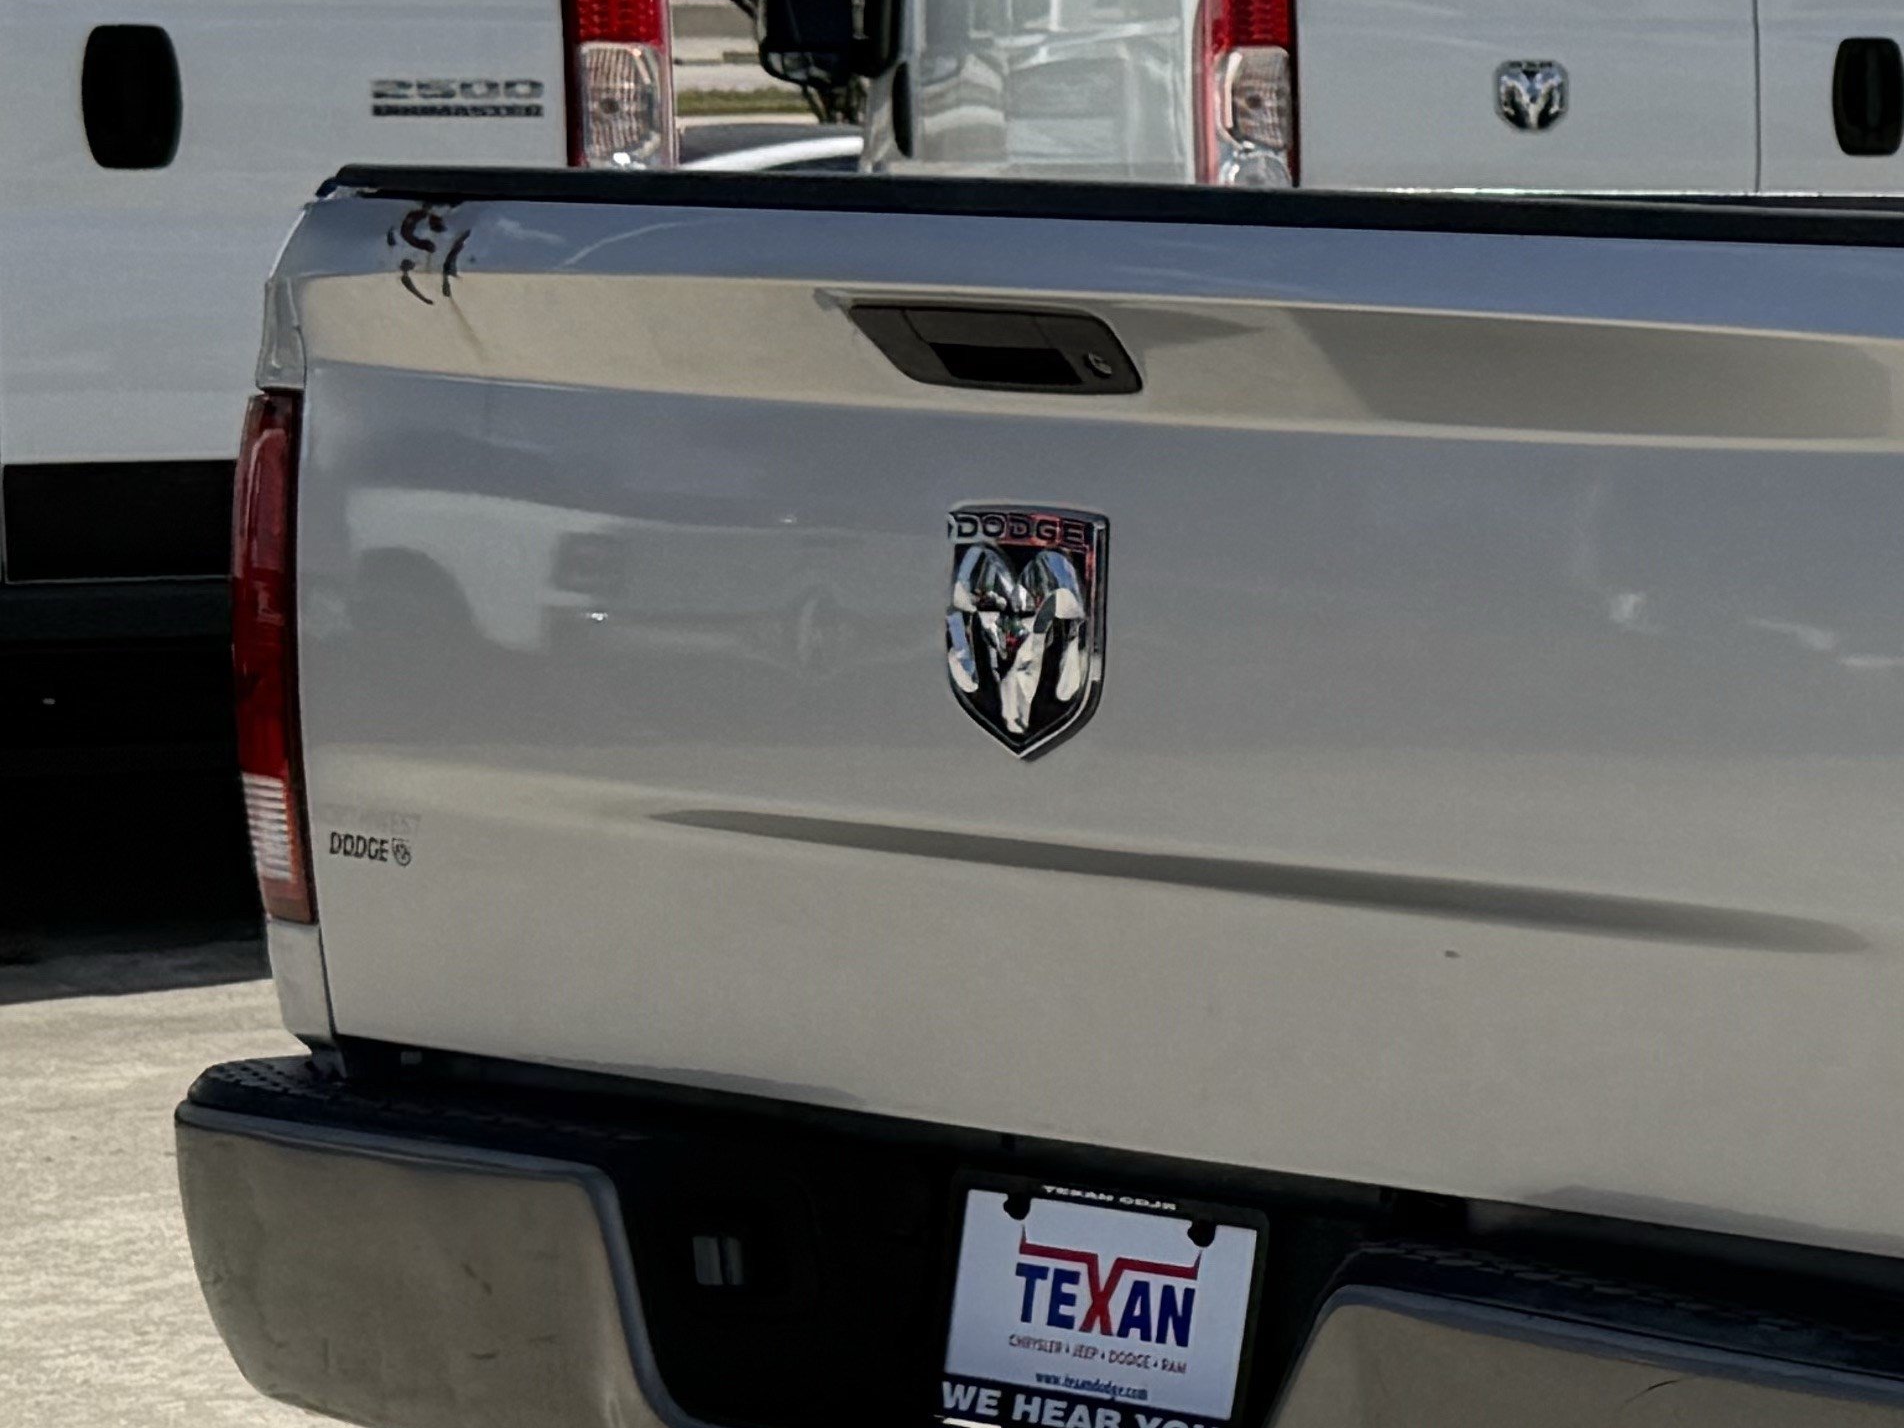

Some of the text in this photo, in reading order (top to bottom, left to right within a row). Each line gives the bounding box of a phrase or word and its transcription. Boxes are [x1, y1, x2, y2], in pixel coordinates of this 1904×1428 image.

[371, 79, 544, 99] 2500
[957, 515, 1085, 543] DODGE
[329, 832, 389, 862] DODGE
[1042, 1185, 1114, 1201] TEXAN
[1015, 1237, 1203, 1349] TEXAN
[1009, 1333, 1188, 1375] CHRYSLER JEEP DODGE RAM
[941, 1380, 1002, 1416] WE
